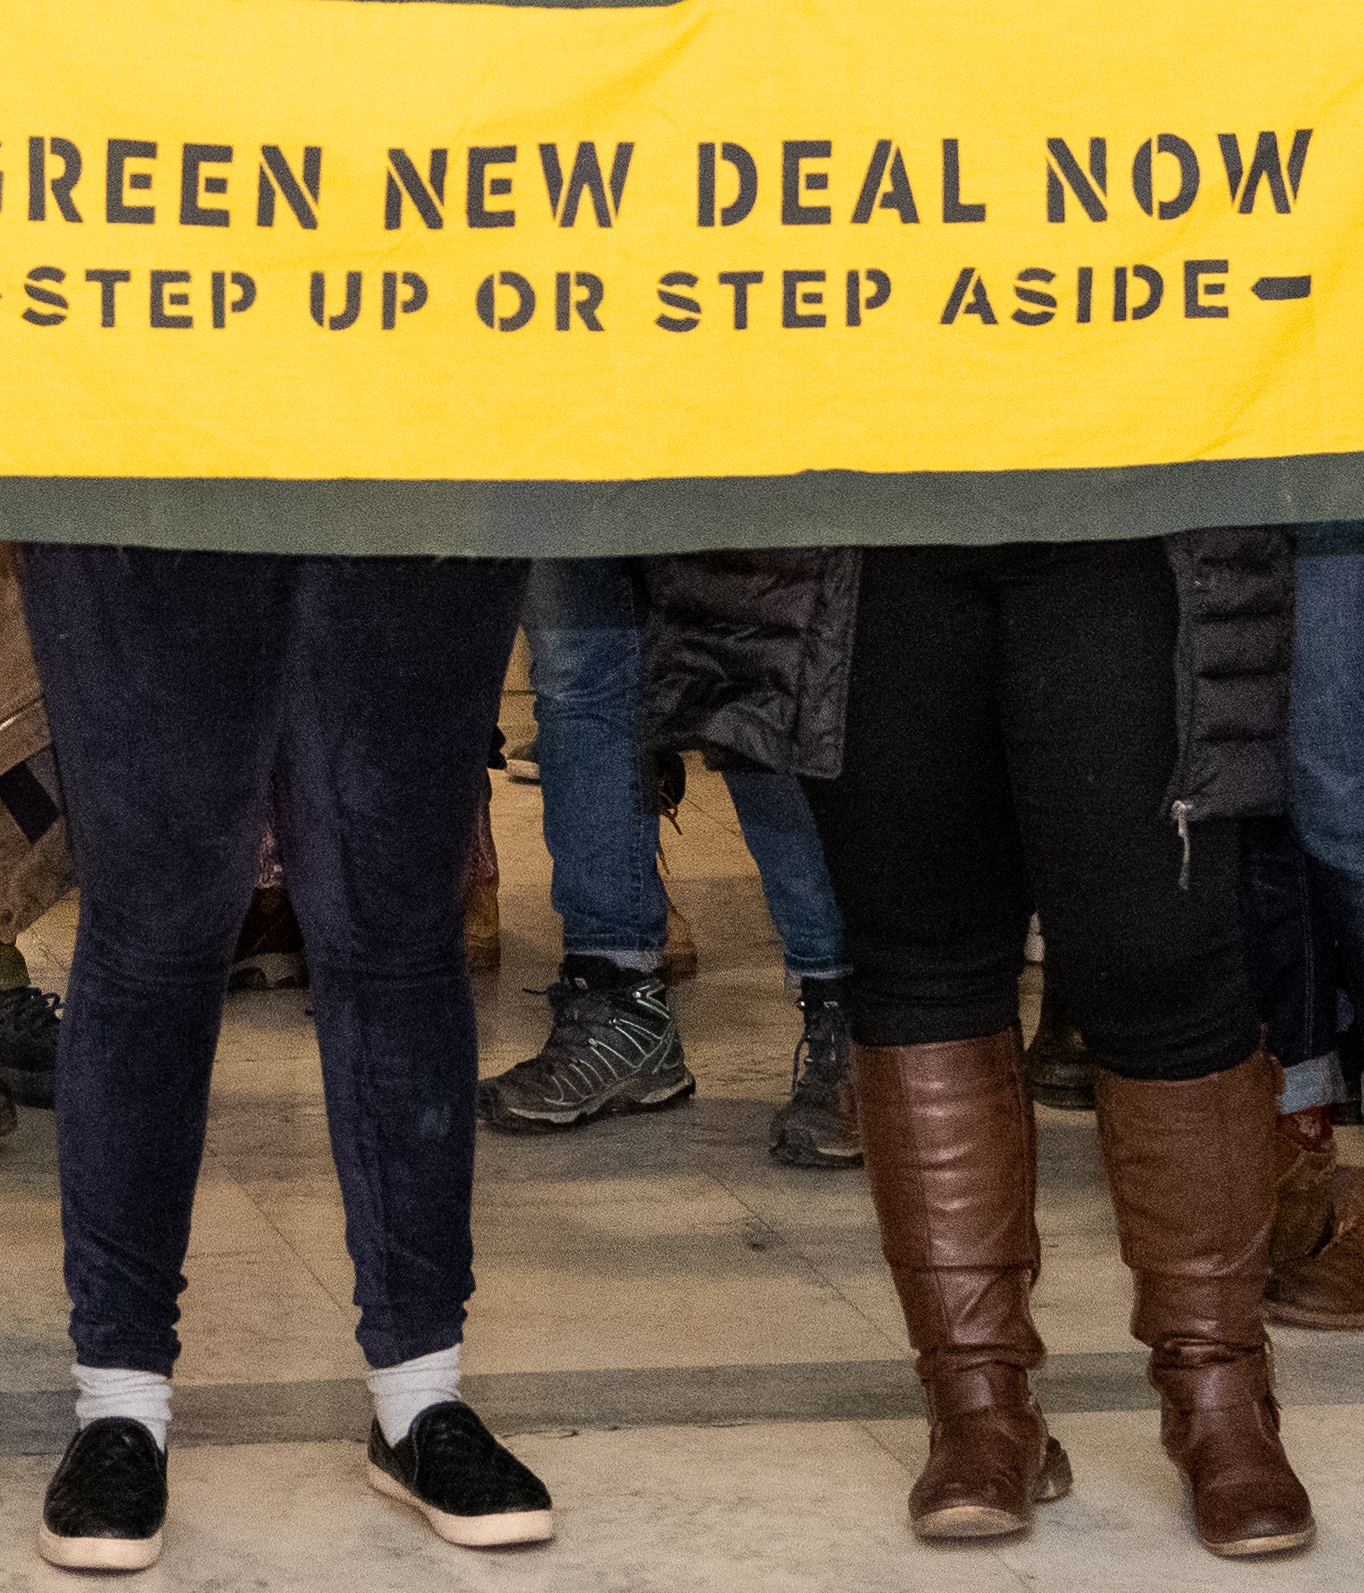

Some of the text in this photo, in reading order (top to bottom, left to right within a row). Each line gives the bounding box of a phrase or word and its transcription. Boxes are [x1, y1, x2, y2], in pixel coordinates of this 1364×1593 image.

[384, 140, 635, 230] NEW
[697, 138, 987, 227] DEAL
[1046, 128, 1314, 224] NOW
[21, 258, 1230, 333] STEP UP OR STEP ASIDE
